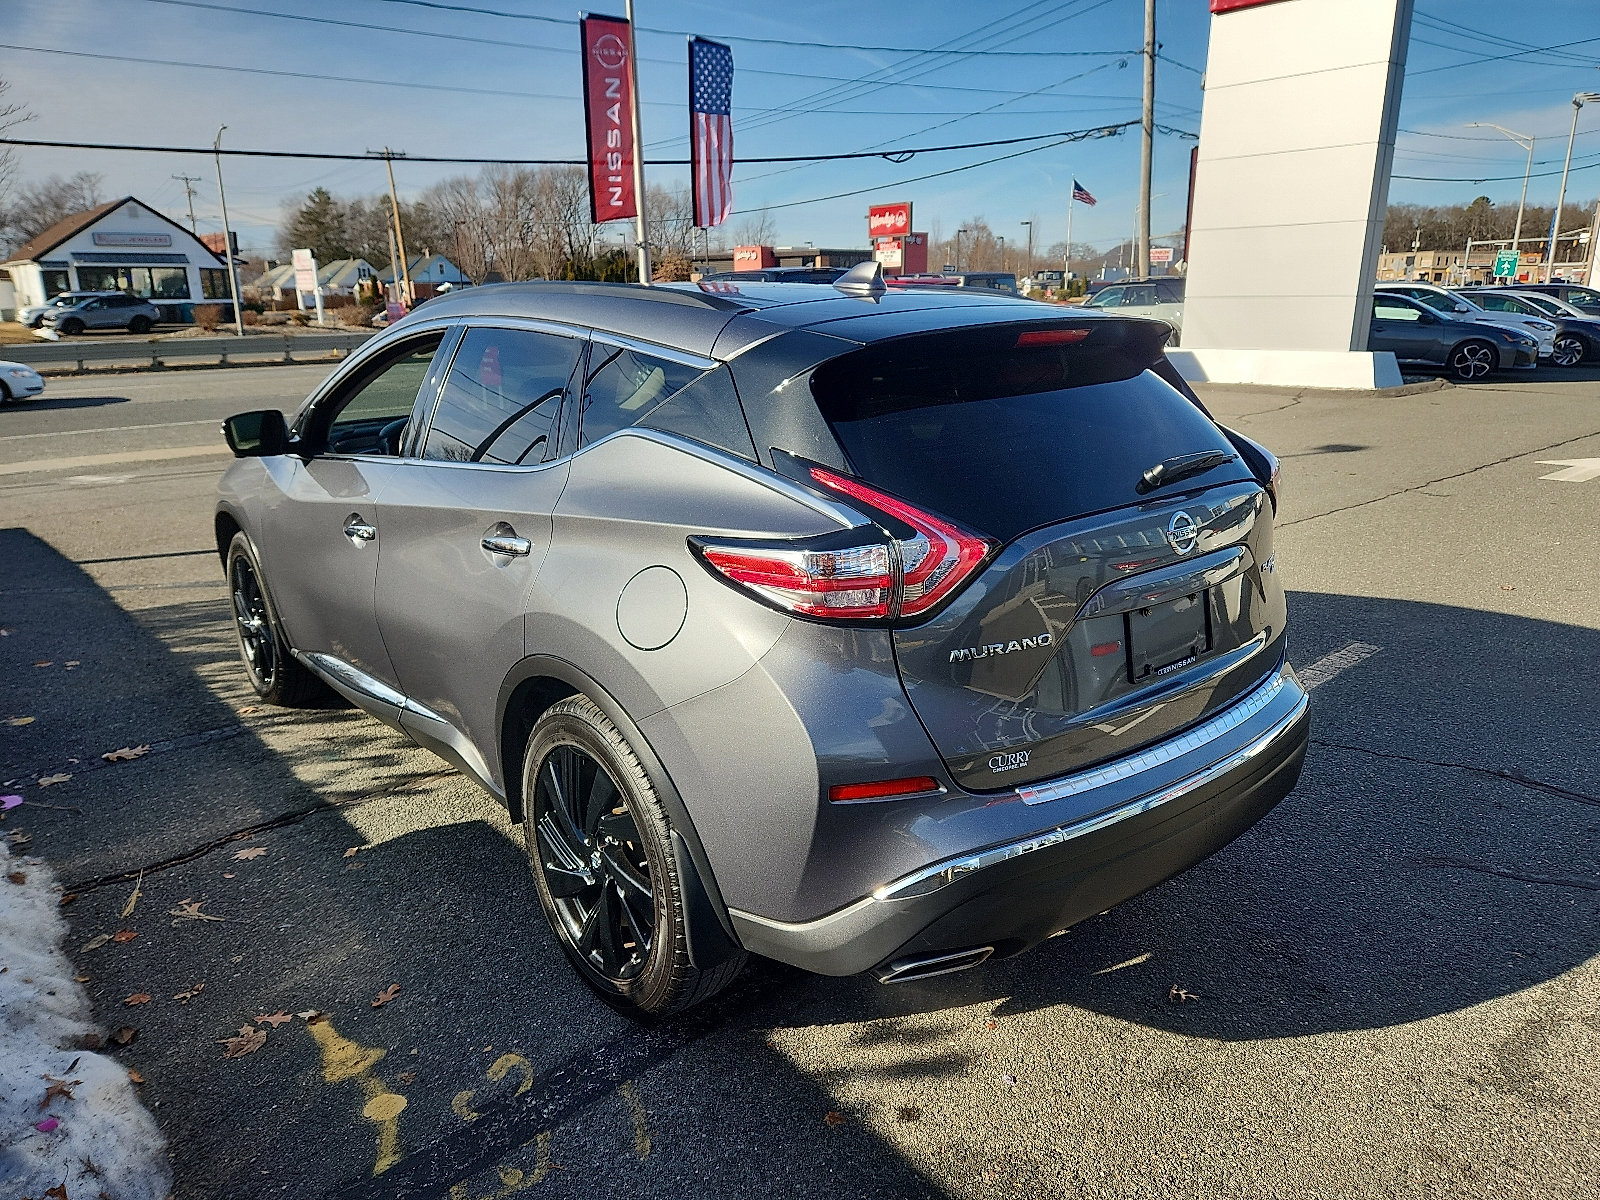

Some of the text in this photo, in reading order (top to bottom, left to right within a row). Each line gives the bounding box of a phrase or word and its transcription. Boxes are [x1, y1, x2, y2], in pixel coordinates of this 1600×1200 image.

[605, 77, 623, 206] NISSAN
[949, 633, 1052, 662] MURANO
[988, 749, 1032, 769] CURRY
